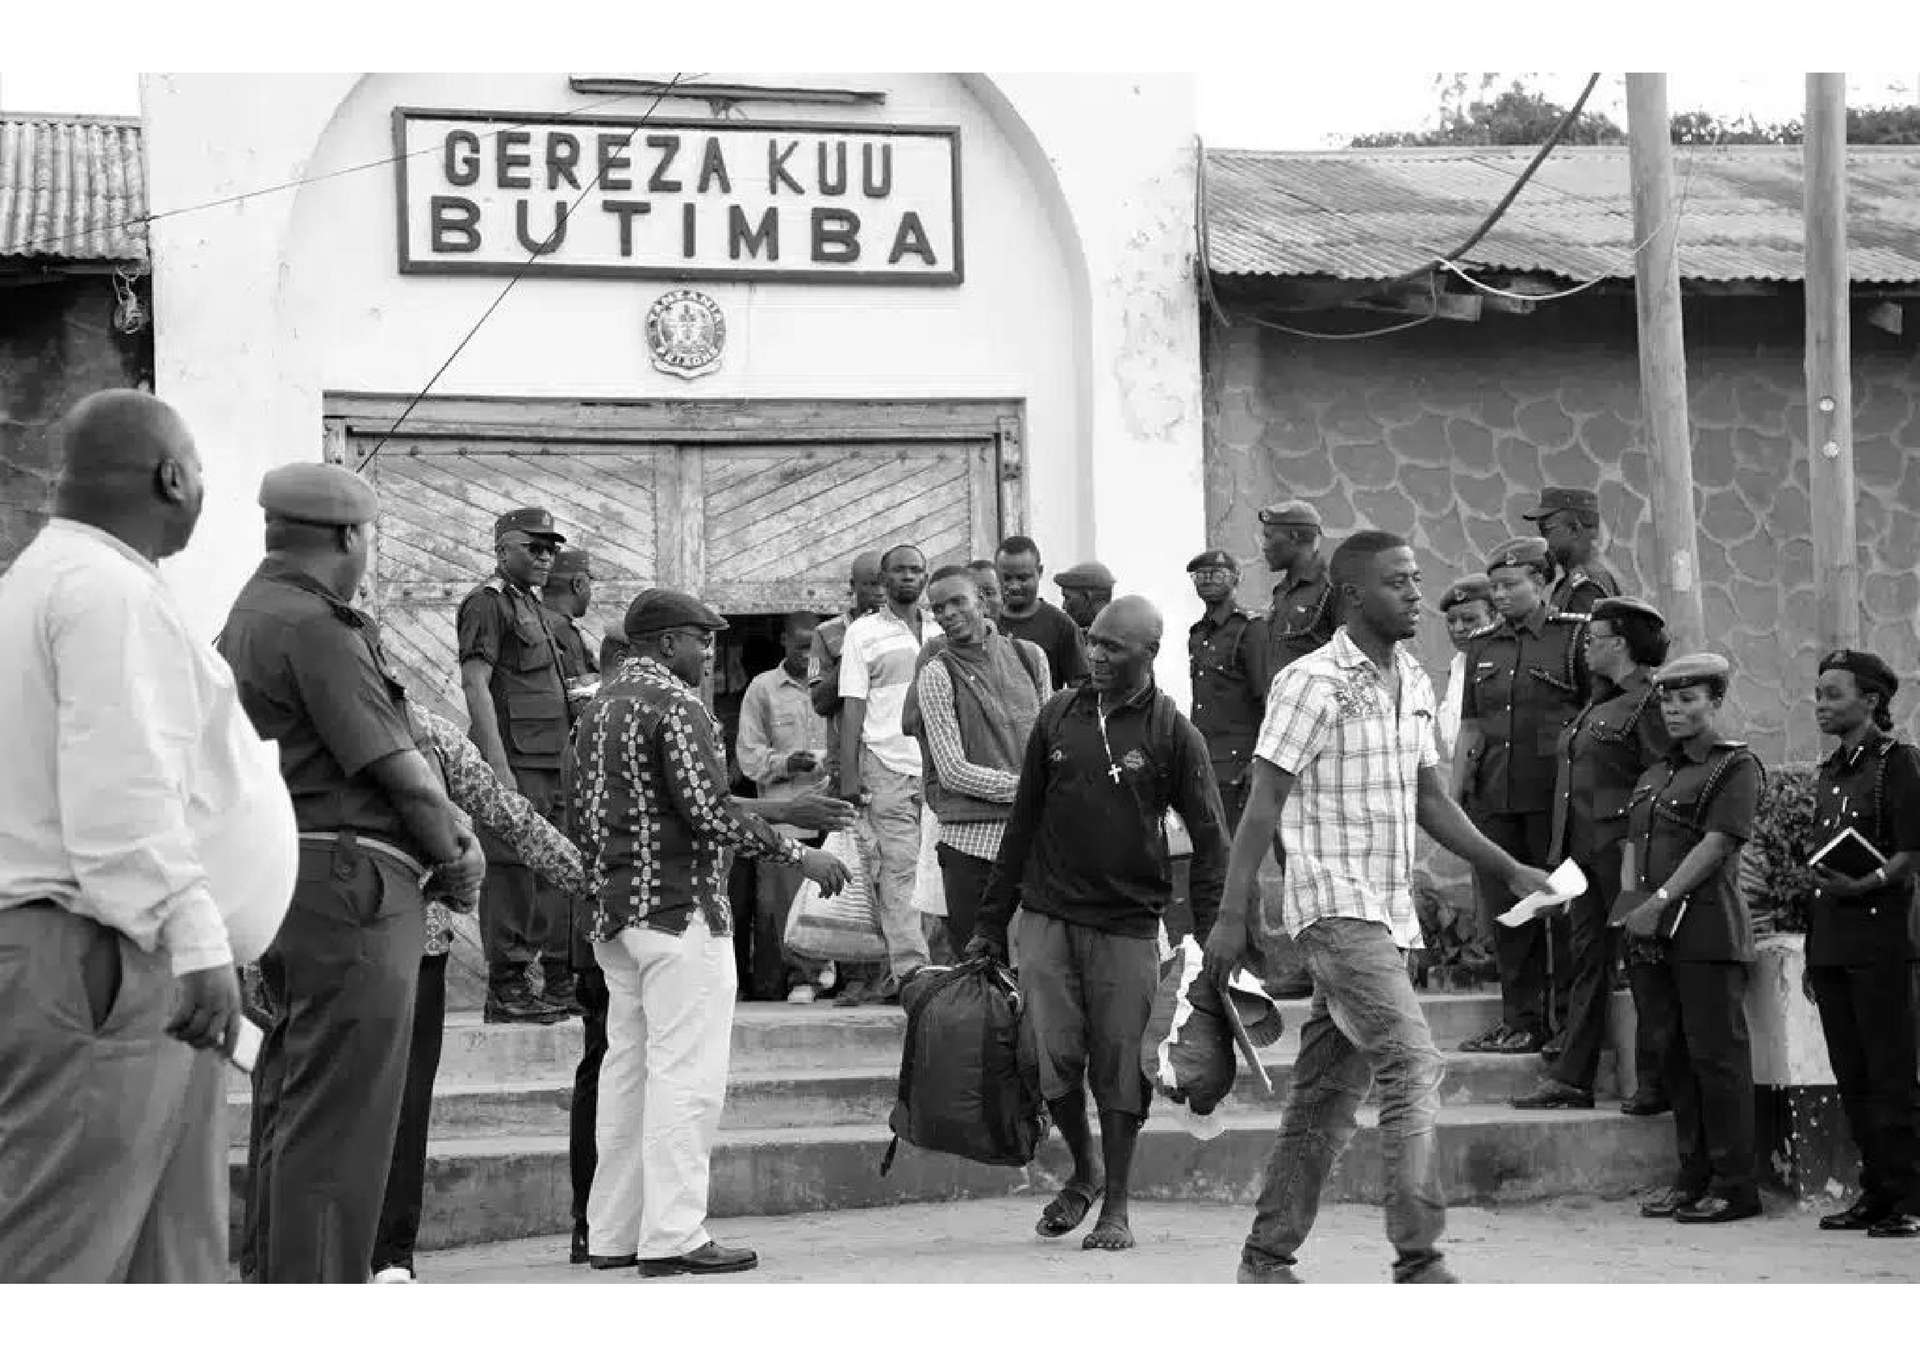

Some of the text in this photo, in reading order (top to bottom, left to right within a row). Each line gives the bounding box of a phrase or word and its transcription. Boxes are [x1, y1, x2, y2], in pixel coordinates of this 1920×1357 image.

[445, 130, 892, 200] GEREZA KUU
[431, 195, 937, 267] BUTIMBA
